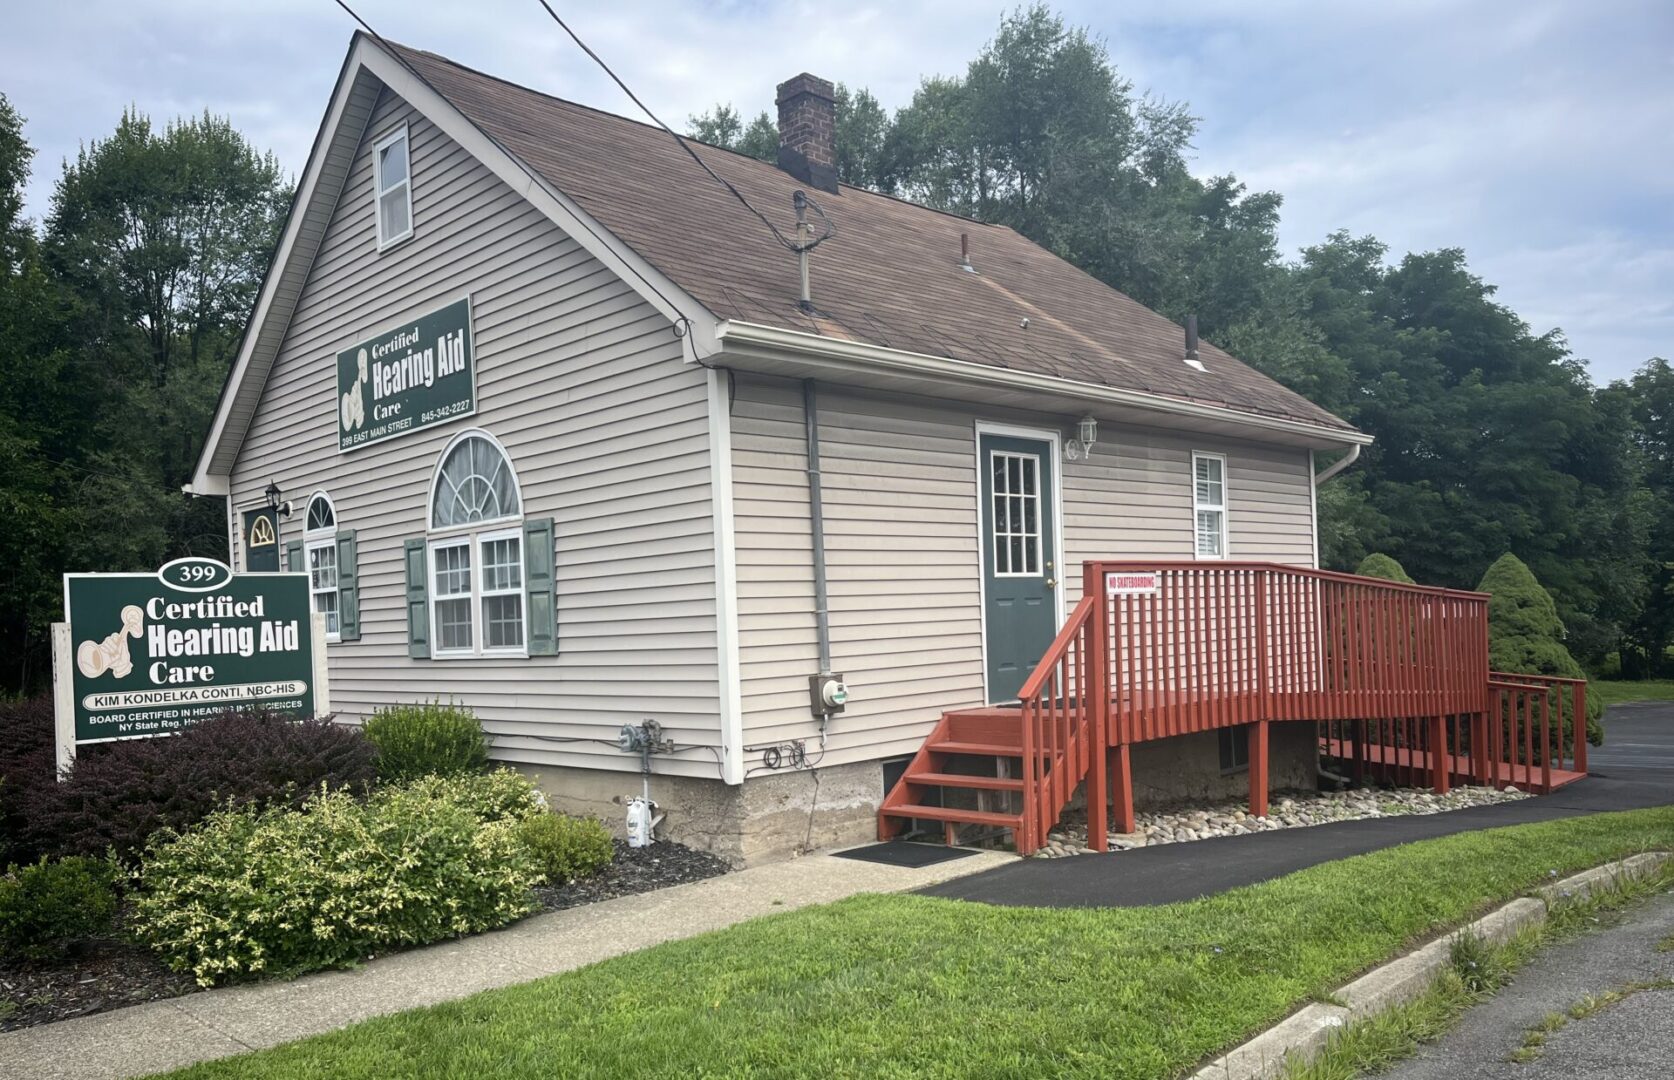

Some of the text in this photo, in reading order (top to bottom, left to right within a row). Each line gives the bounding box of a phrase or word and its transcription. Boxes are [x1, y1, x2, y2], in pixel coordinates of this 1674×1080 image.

[372, 326, 419, 360] Certified
[372, 328, 465, 400] Hearing Aid
[342, 399, 470, 447] 399 EAST MAIN STREET 845-342-2227
[373, 401, 401, 421] Care
[179, 566, 216, 582] 399
[1109, 576, 1154, 589] NO SKATEBOARDING
[146, 595, 264, 620] Certified
[147, 620, 299, 658] Hearing Aid
[149, 661, 215, 685] Care
[94, 696, 119, 707] KIM
[124, 690, 198, 705] KONDELKA
[247, 683, 295, 696] NBC-HIS
[89, 714, 126, 724] BOARD
[128, 709, 179, 721] CERTIFIED
[181, 708, 190, 717] IN
[261, 700, 303, 710] CIENCES
[119, 723, 133, 731] NY
[135, 721, 159, 730] State
[161, 719, 181, 729] Reg.
